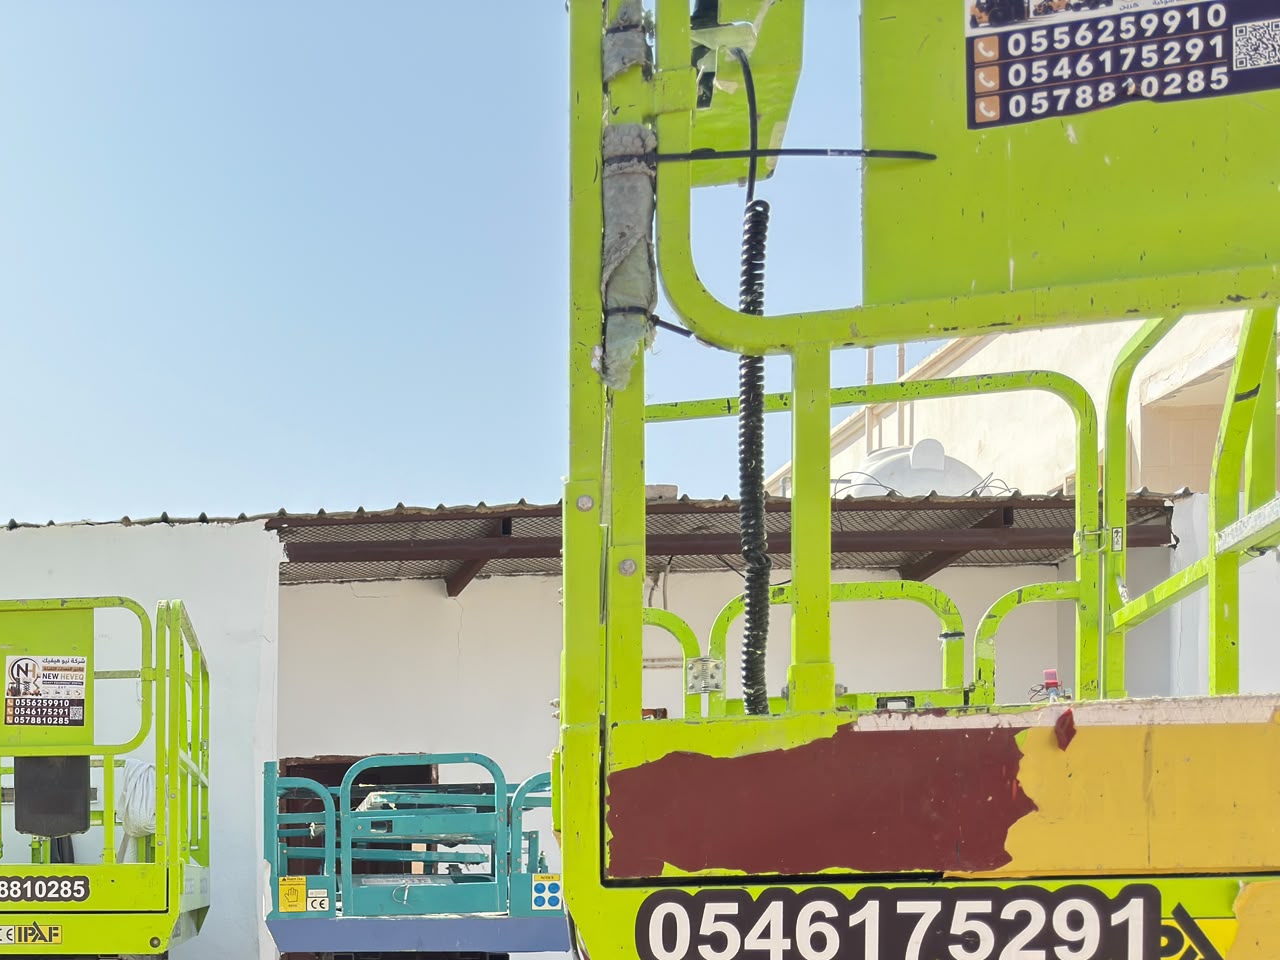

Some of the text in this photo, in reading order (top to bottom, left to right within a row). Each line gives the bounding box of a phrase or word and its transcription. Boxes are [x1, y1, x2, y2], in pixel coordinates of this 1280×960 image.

[1008, 4, 1227, 56] 0556259910
[1008, 36, 1224, 86] 0546175291
[15, 699, 69, 707] 0556259910
[311, 899, 326, 909] CE
[17, 920, 59, 943] IPAF
